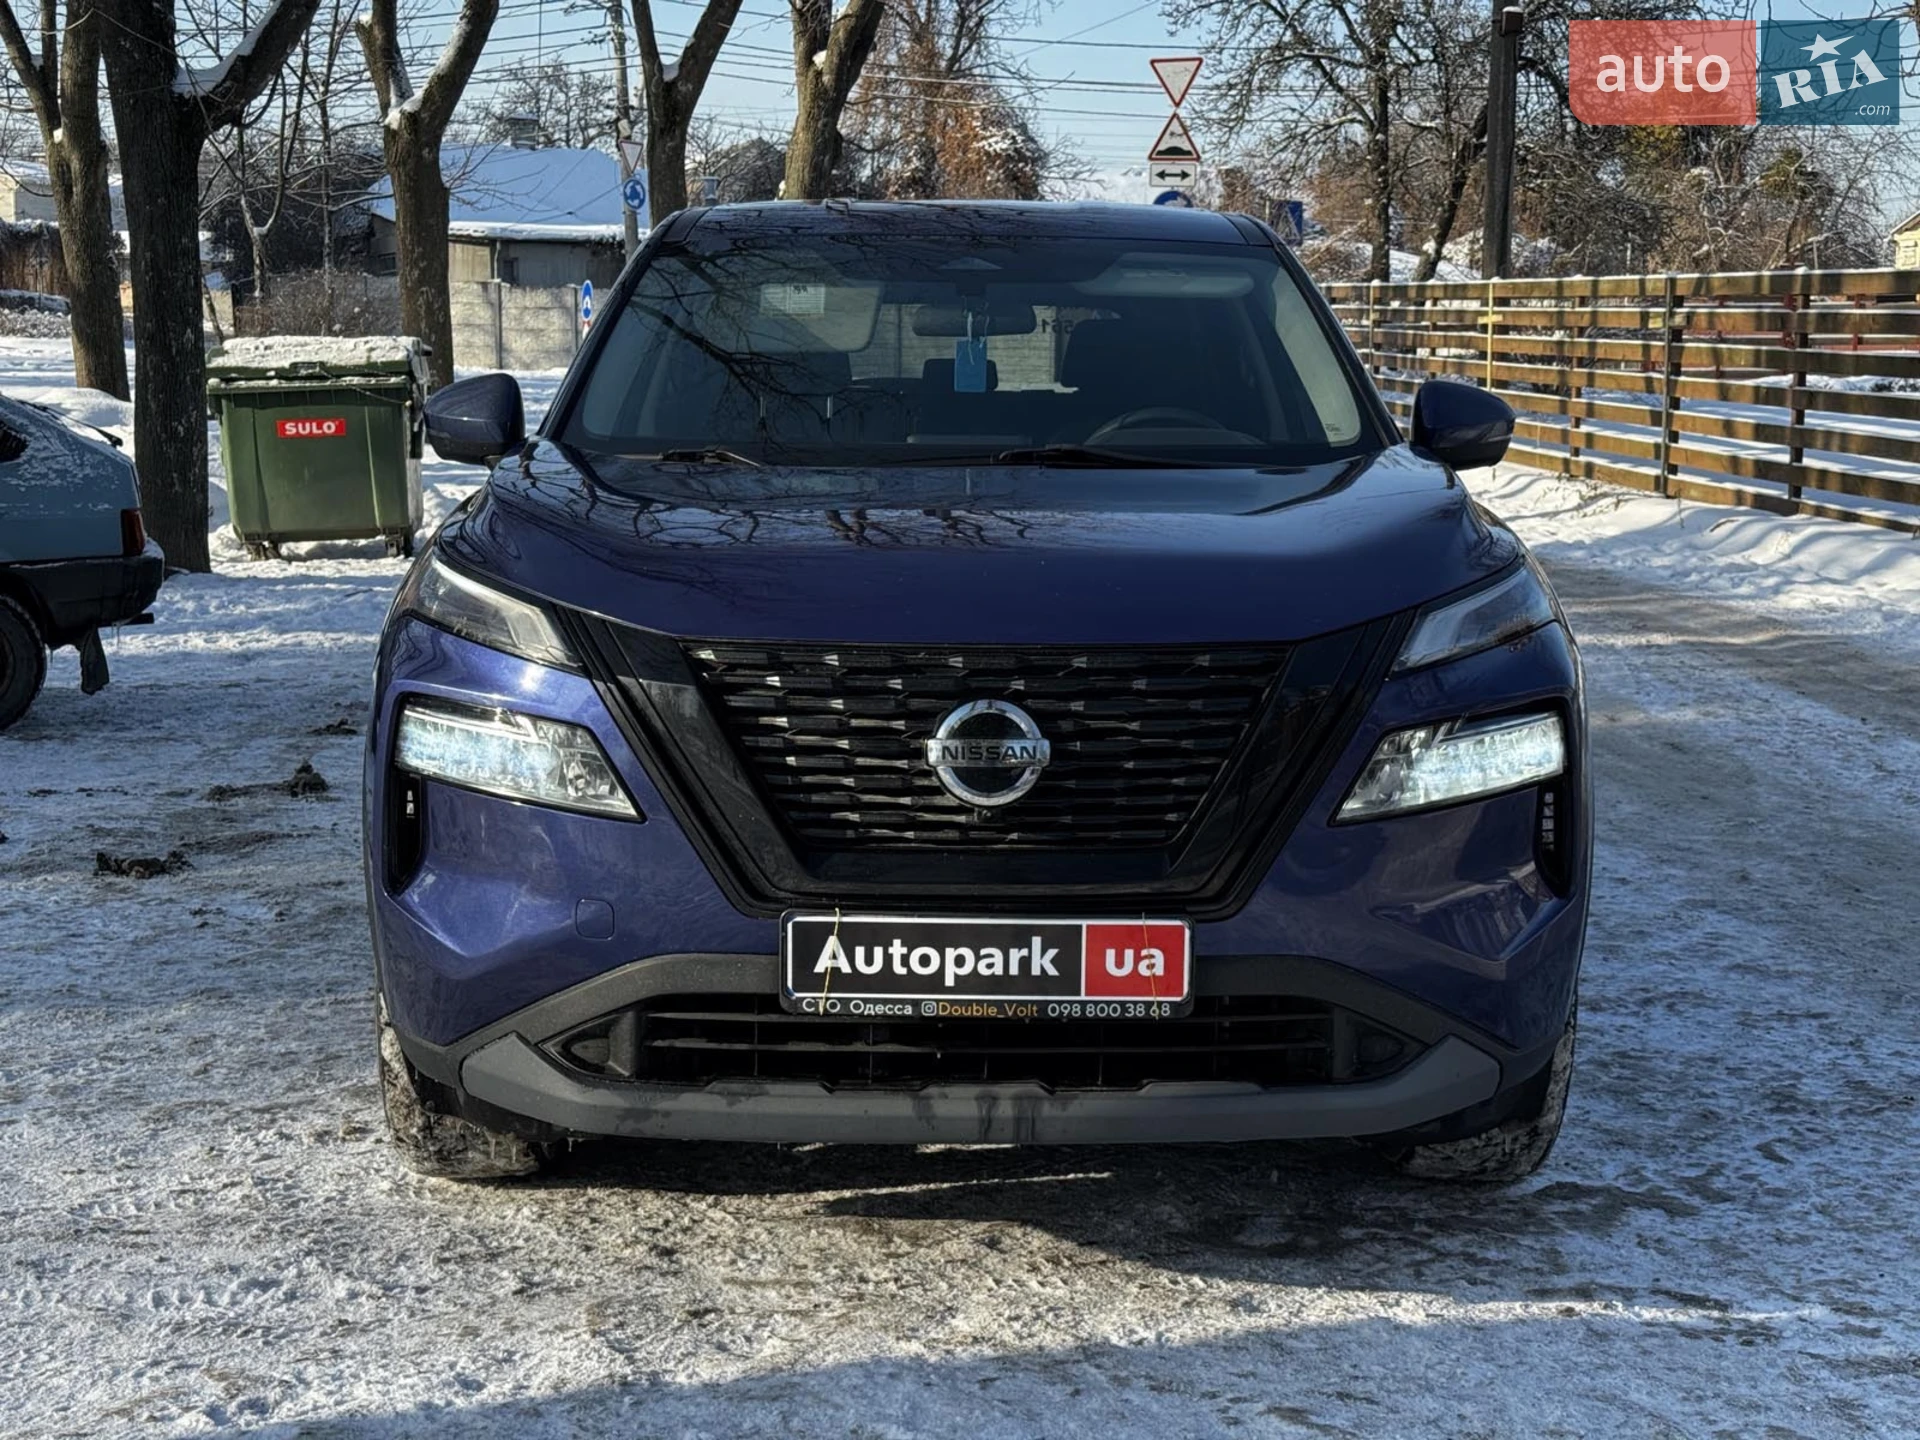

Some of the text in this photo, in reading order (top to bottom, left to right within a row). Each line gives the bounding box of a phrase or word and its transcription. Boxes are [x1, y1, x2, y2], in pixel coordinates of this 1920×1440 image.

[285, 421, 336, 435] SULO
[941, 745, 1037, 760] NISSAN
[813, 935, 1165, 987] Autopark ua
[850, 1000, 912, 1015] Одесса
[938, 1002, 1038, 1018] Double_Volt
[1048, 1003, 1082, 1017] 098
[1085, 1003, 1121, 1017] 800
[1124, 1003, 1145, 1017] 38
